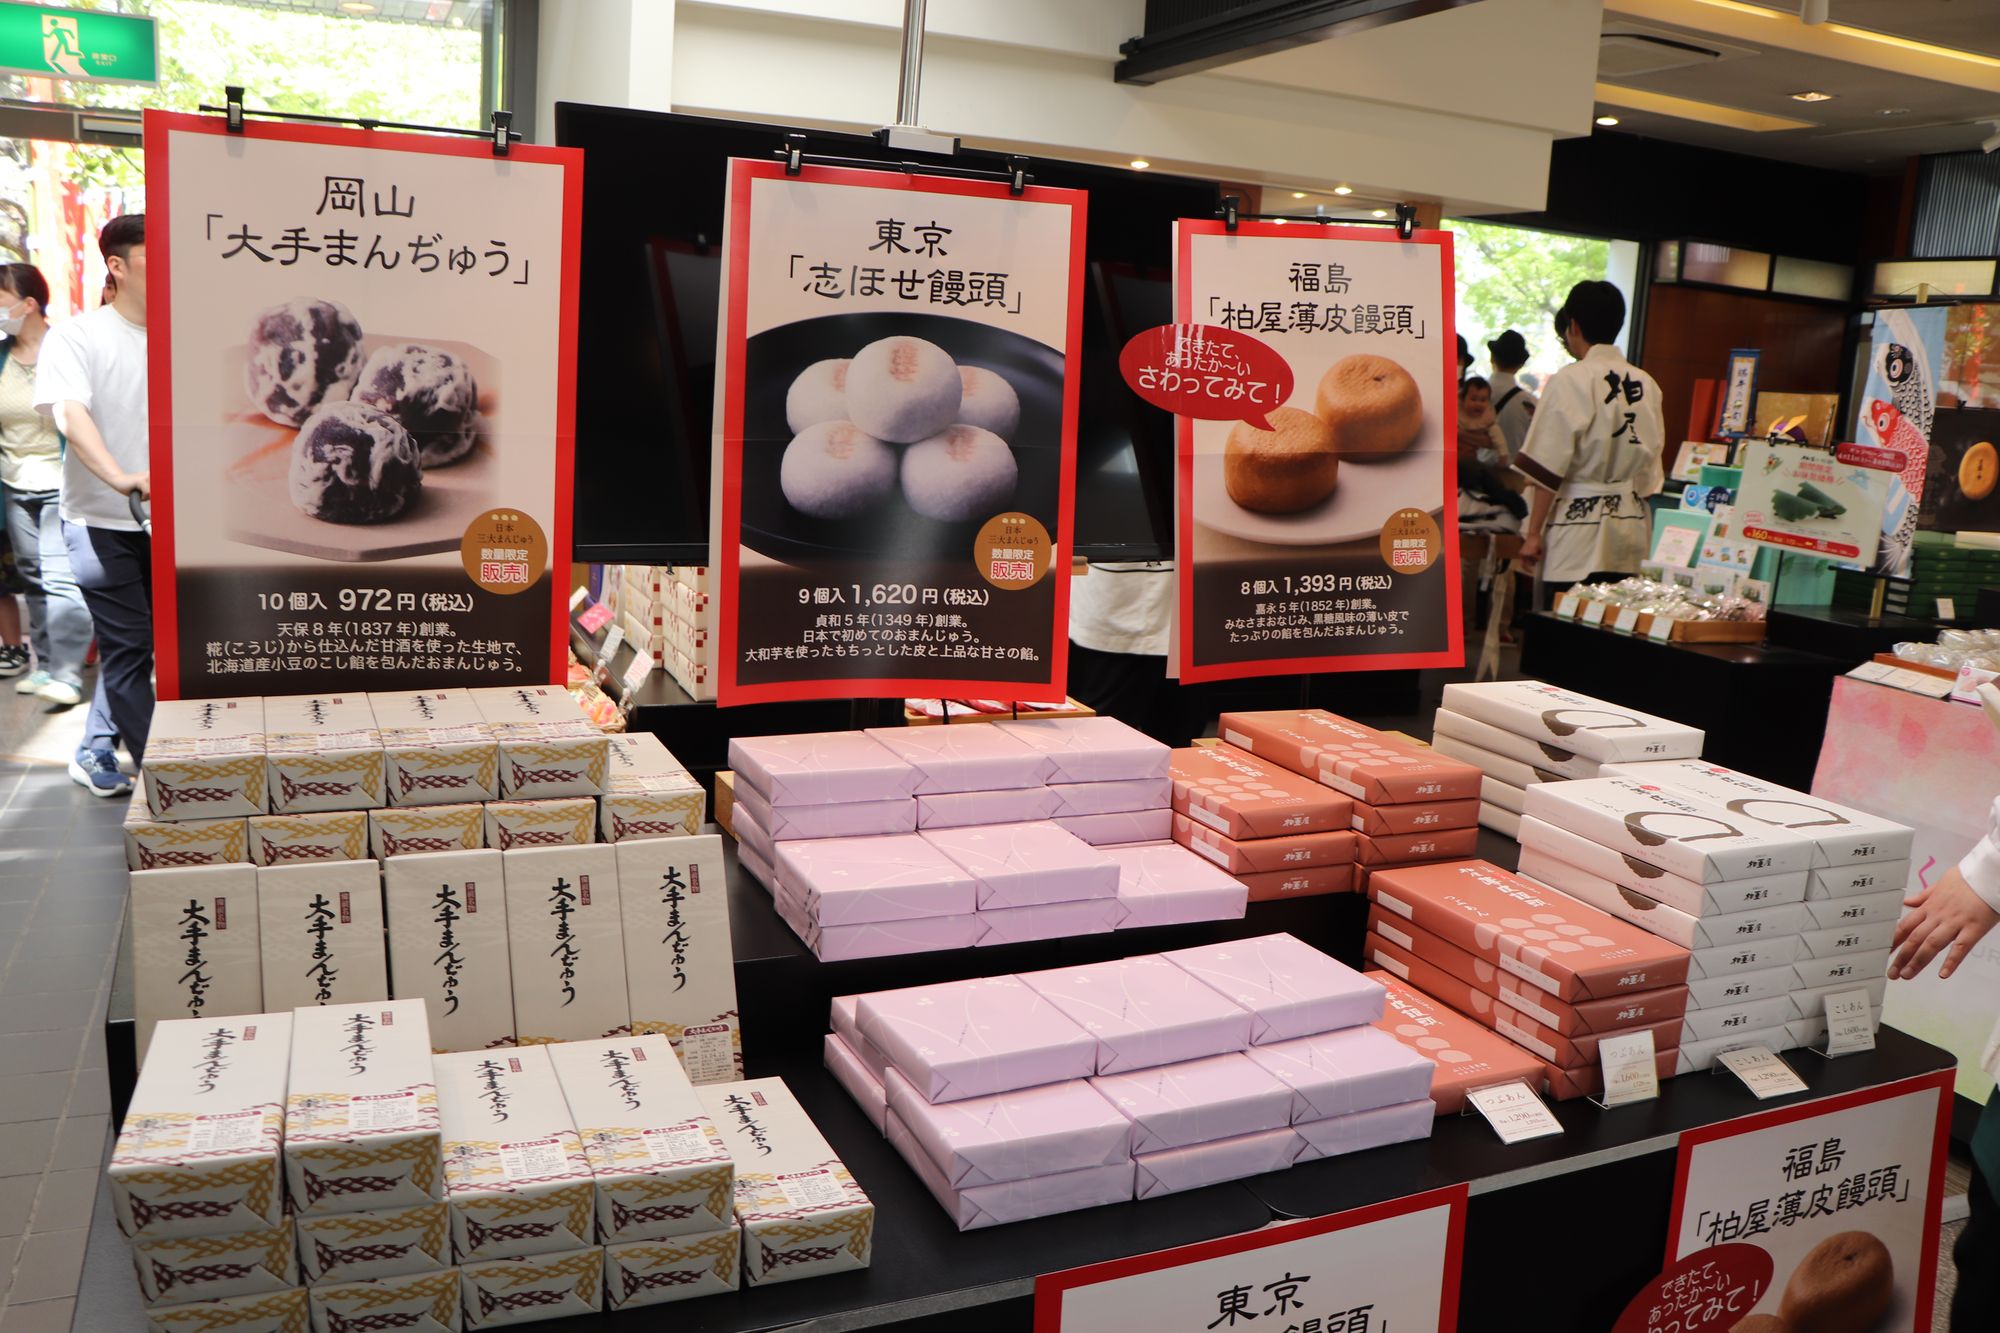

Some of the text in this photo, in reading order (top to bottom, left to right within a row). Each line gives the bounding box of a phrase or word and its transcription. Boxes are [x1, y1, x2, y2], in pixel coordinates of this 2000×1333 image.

[316, 176, 415, 218] 岡山
[206, 213, 529, 284] 「大手まんぢゅう」
[868, 218, 953, 258] 東京
[790, 254, 1021, 314] 「志ほせ饅頭」
[1288, 262, 1352, 295] 福島
[1210, 297, 1425, 339] 「柏屋薄皮饅頭」
[1178, 337, 1240, 360] できたて、
[481, 548, 528, 560] 数量限定
[803, 629, 981, 644] 日本で初めてのおまんじゅう。
[1230, 623, 1405, 643] たっぷりの餡を包んだおまんじゅう。
[305, 894, 339, 1006] 大手まんぢゅ
[432, 884, 466, 1018] 大手まんぢゅう
[548, 878, 582, 1008] 大手まんぢゅう
[659, 866, 692, 993] 大手まんぢゅう
[1782, 1137, 1846, 1182] 福島
[1696, 1164, 1910, 1246] 「柏屋薄皮饅頭」
[1207, 1272, 1311, 1329] 東京
